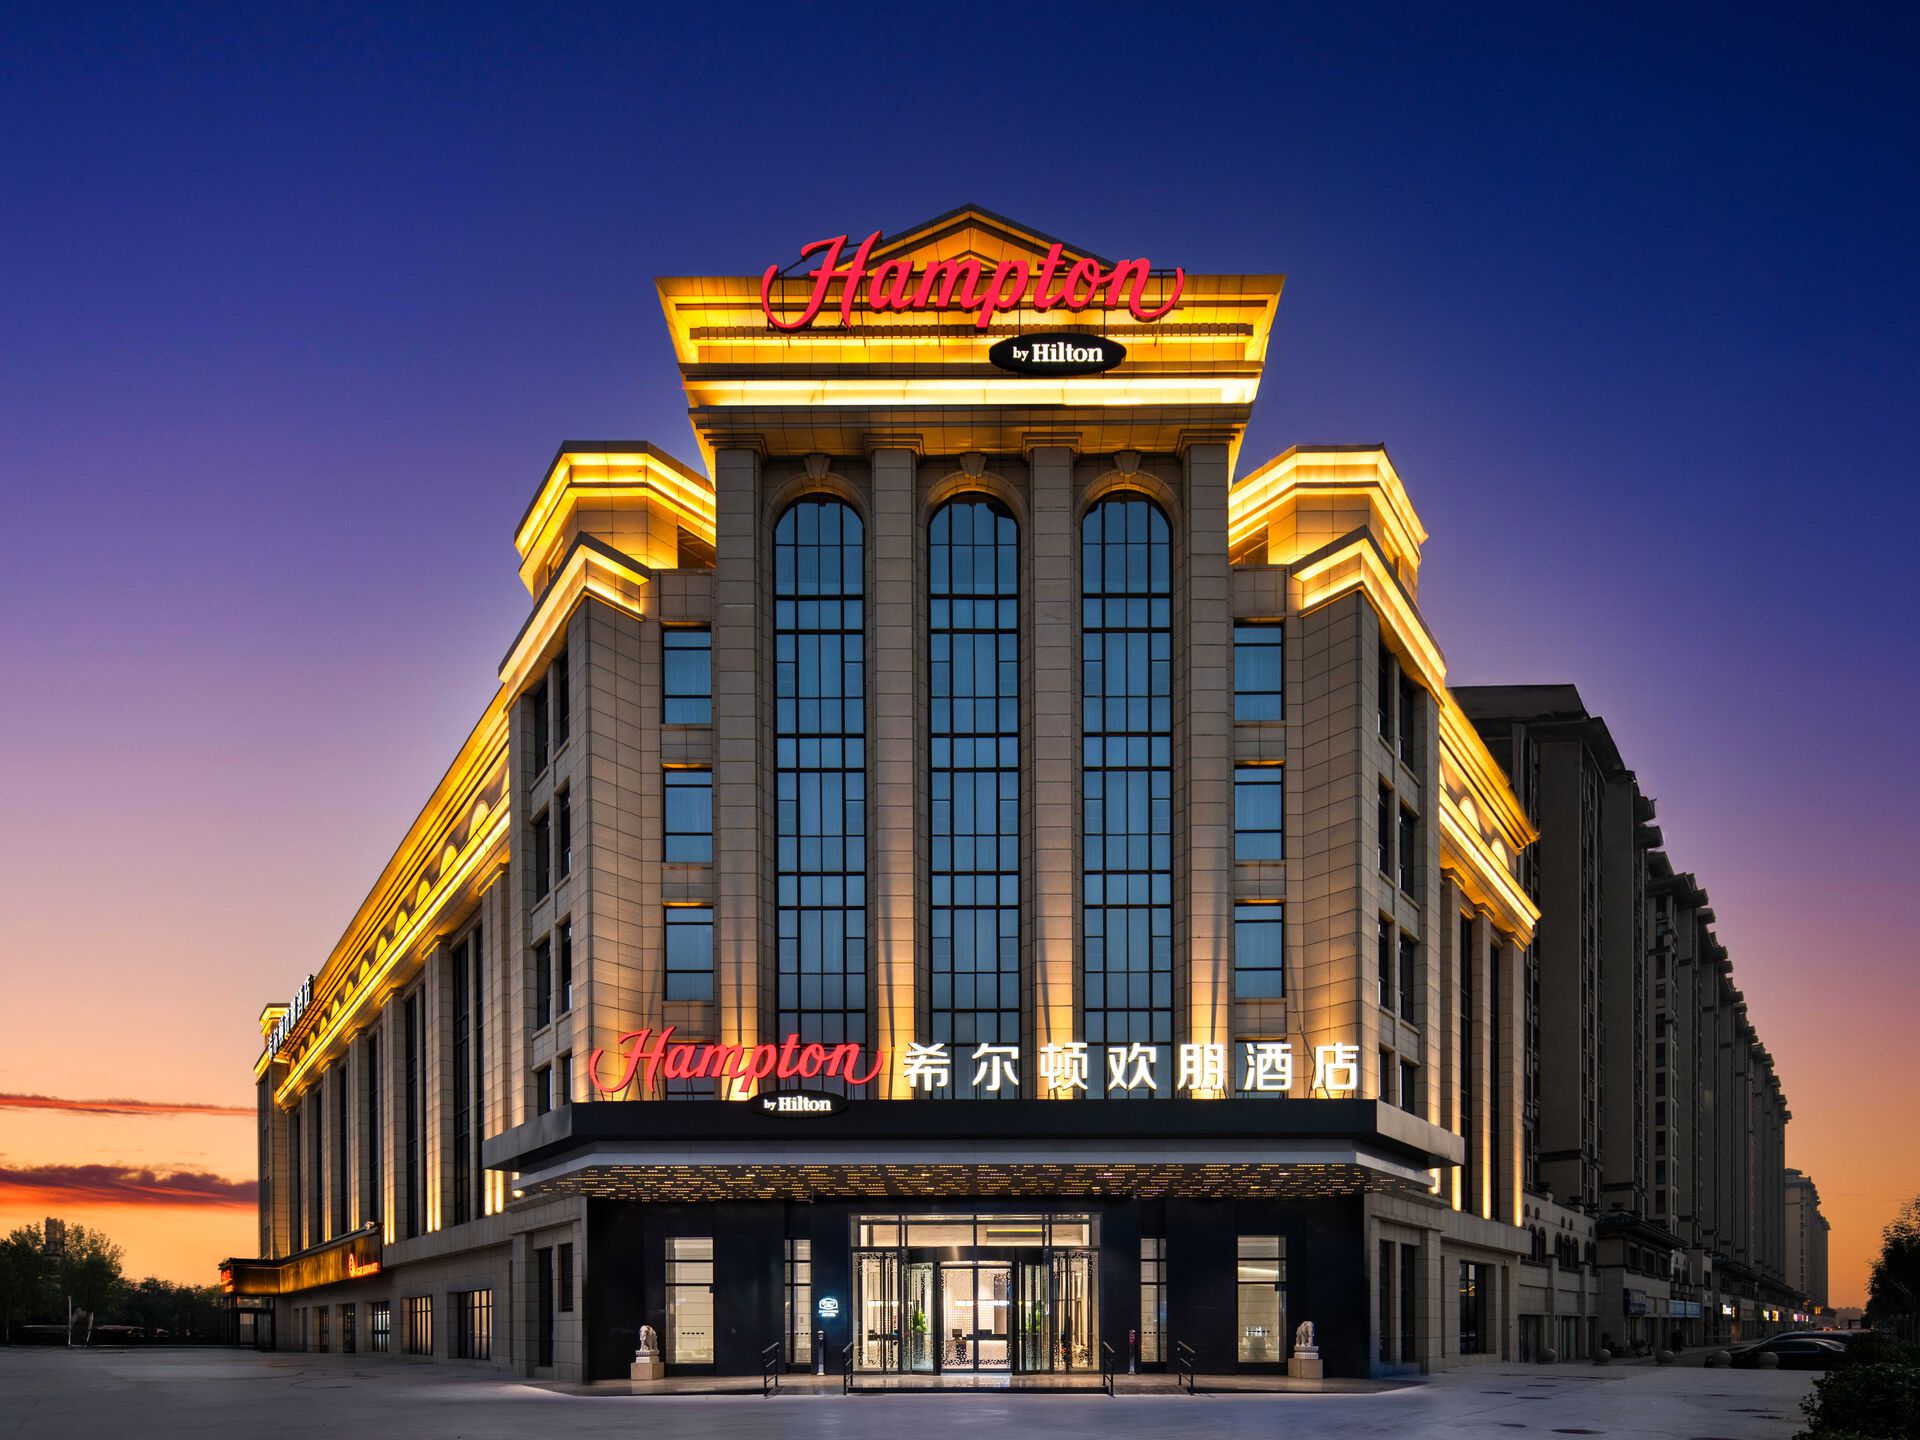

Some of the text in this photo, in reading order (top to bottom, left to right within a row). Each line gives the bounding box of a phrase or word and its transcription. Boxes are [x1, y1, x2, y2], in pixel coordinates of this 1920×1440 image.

[761, 230, 1184, 328] Hampton
[1012, 341, 1104, 362] by Hilton
[588, 1025, 884, 1093] Hampton
[903, 1042, 1360, 1092] 希尔顿欢朋酒店
[763, 1095, 832, 1112] by Hilton
